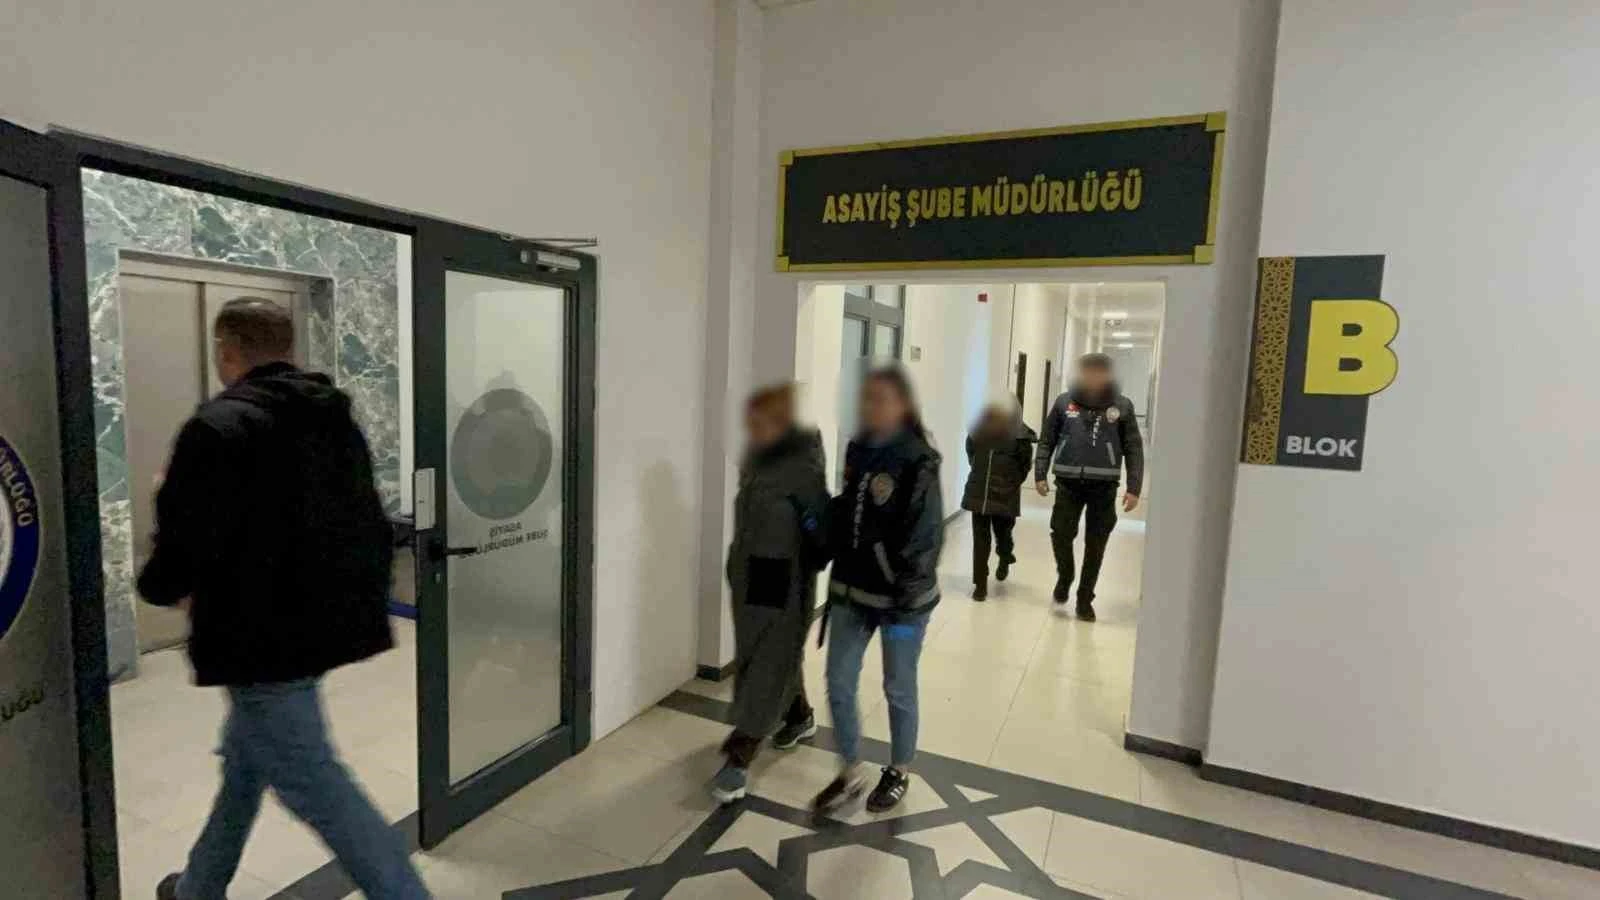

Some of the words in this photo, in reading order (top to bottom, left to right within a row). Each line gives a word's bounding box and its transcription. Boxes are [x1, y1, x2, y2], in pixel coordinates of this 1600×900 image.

[822, 184, 901, 229] ASAYİŞ
[905, 186, 966, 229] ŞUBE
[971, 168, 1142, 217] MÜDÜRLÜĞÜ
[1304, 299, 1399, 396] B
[1285, 435, 1357, 457] BLOK
